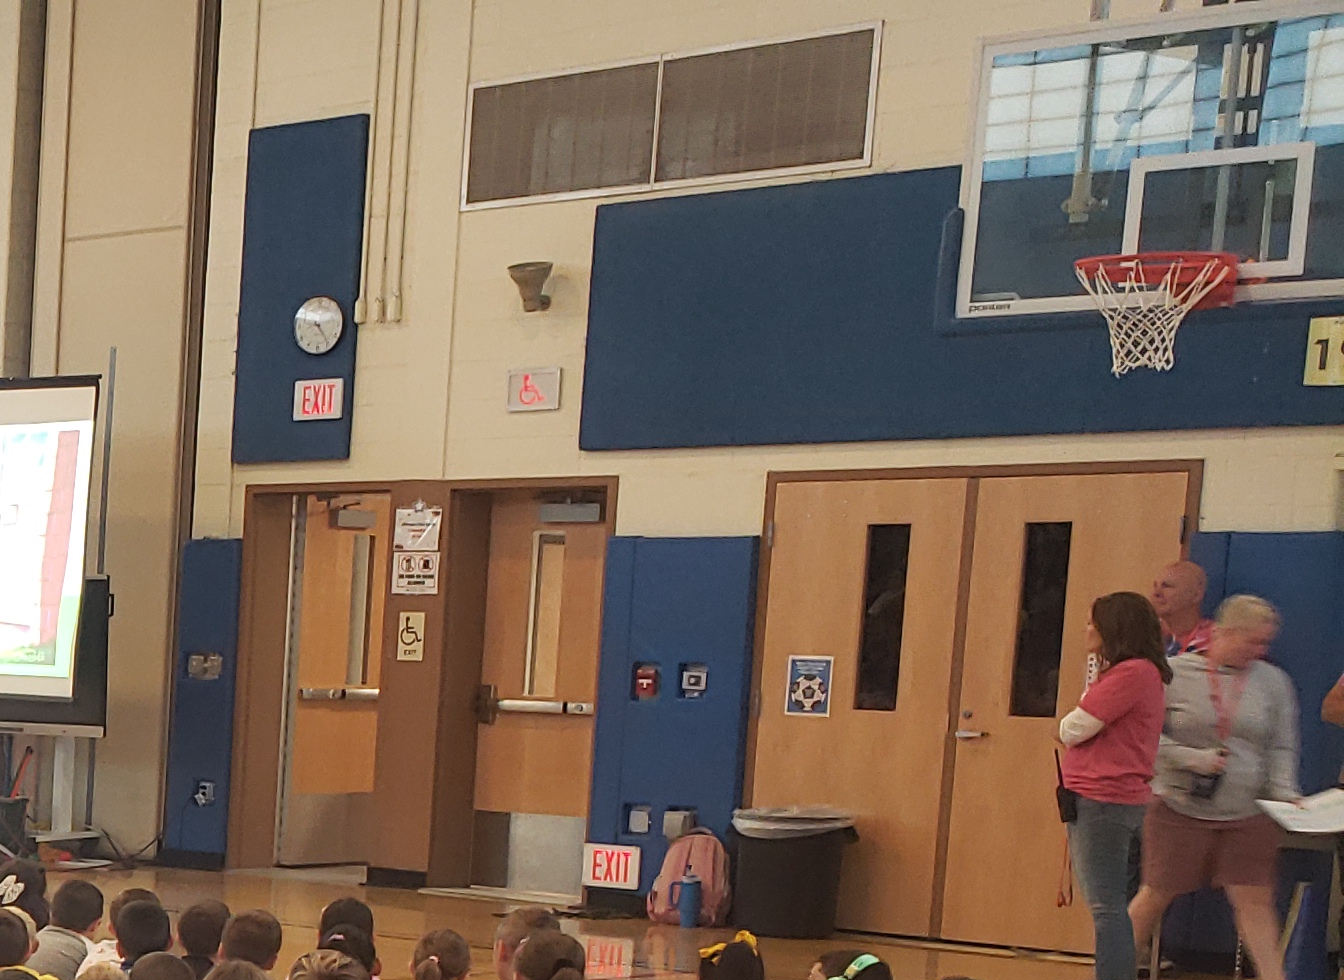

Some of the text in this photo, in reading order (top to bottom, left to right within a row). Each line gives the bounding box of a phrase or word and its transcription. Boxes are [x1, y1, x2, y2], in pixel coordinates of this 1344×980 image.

[1313, 338, 1344, 371] 1
[303, 384, 336, 415] EXIT
[592, 849, 632, 884] EXIT
